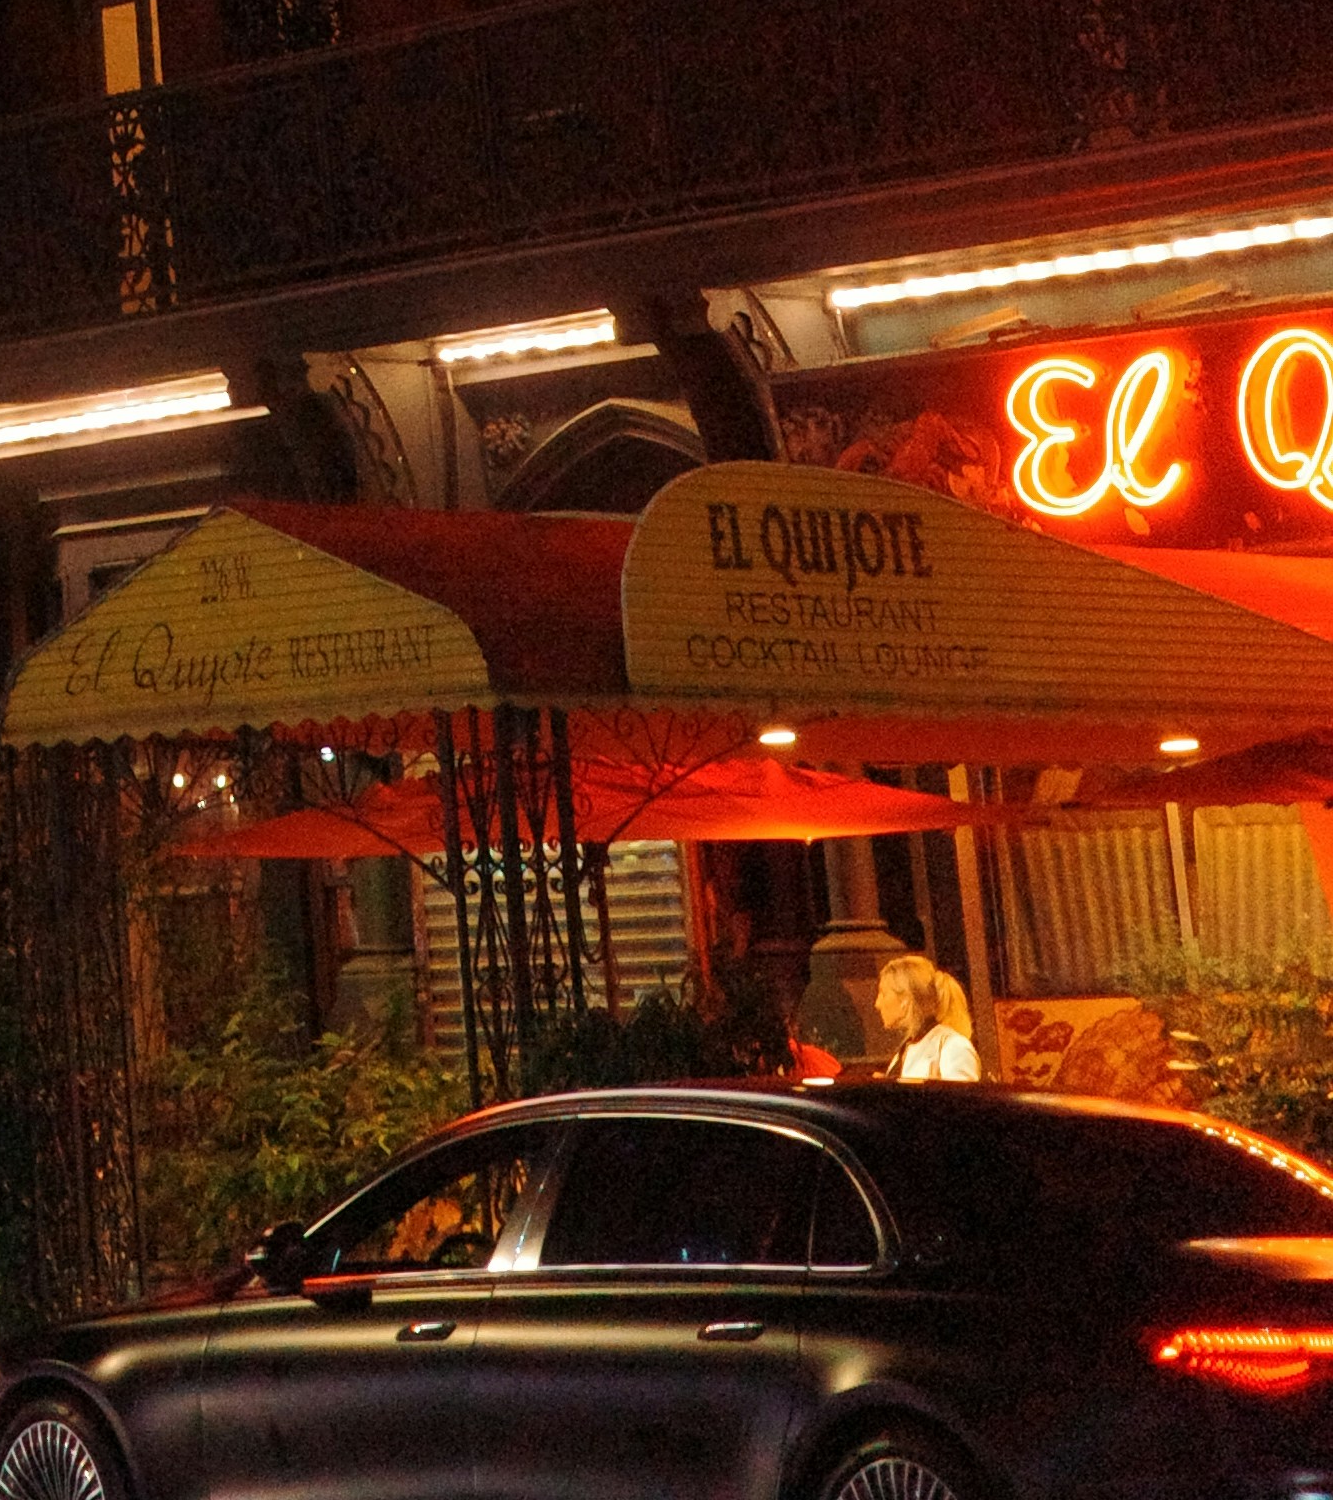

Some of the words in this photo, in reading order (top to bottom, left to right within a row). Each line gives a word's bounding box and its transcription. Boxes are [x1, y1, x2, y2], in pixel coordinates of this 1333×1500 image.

[1006, 351, 1182, 517] El
[707, 503, 753, 570] EL
[760, 504, 933, 592] QUIJOTE
[726, 592, 939, 632] RESTAURANT
[65, 628, 122, 696] El
[134, 623, 273, 705] Quijote
[290, 625, 432, 679] RESTAURANT
[687, 634, 847, 671] COCKTAIL
[857, 642, 989, 677] LOUNGE
